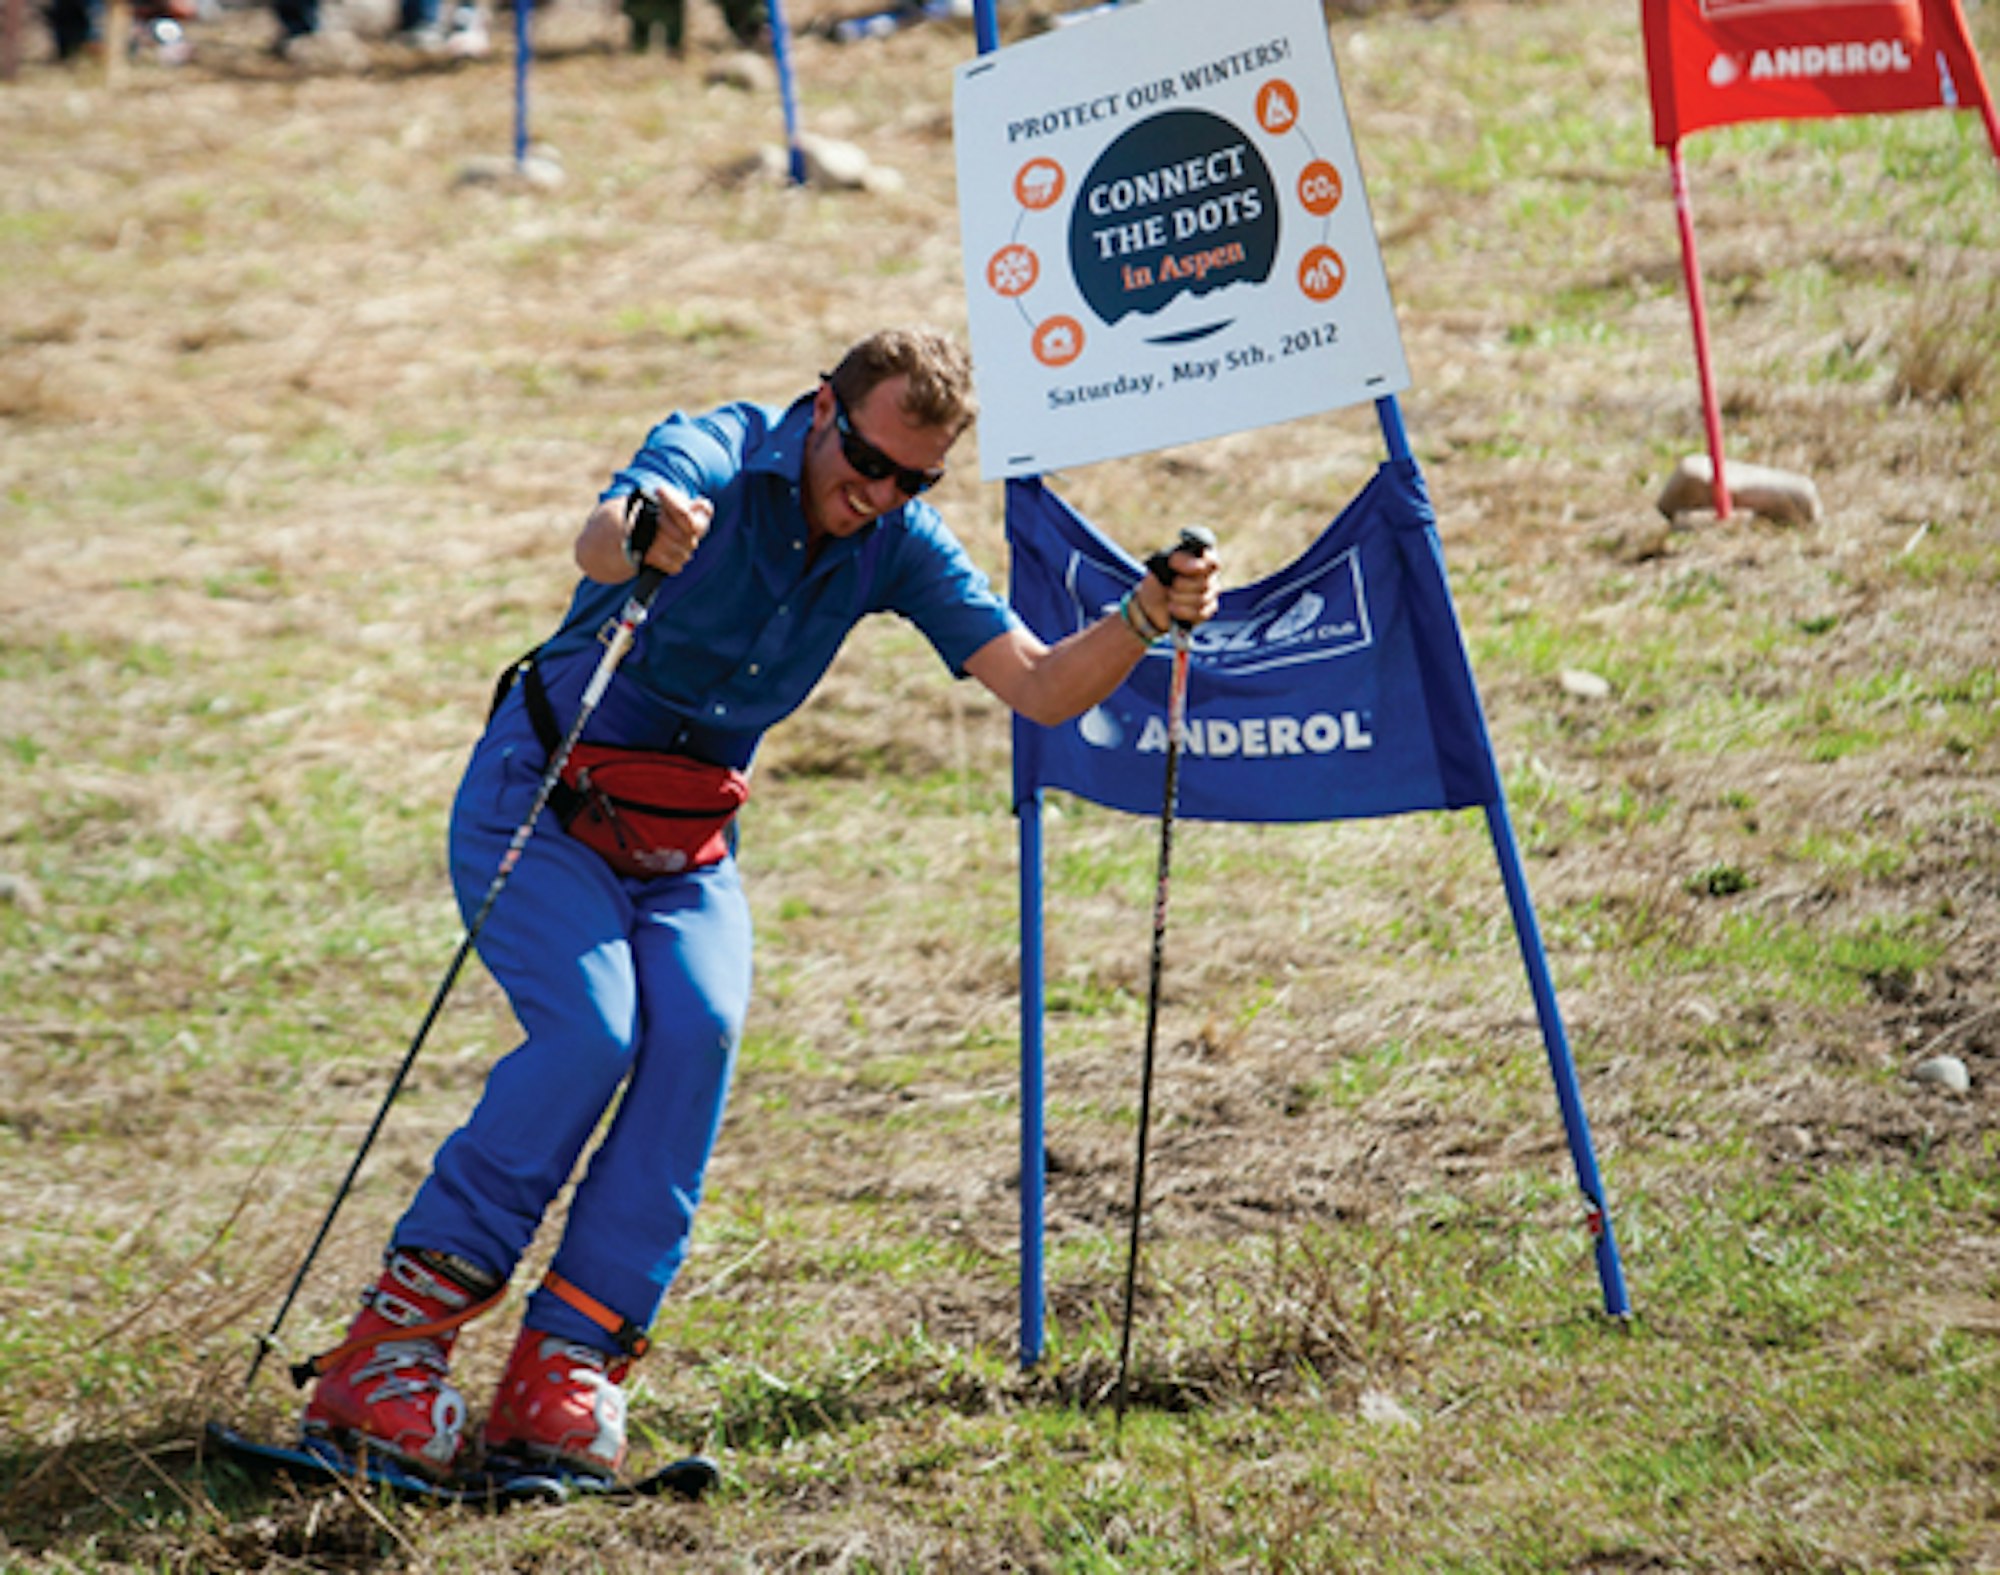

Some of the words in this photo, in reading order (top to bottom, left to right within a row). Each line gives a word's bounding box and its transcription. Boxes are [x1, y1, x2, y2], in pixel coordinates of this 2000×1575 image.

[1007, 94, 1121, 143] PROTECT
[1125, 78, 1178, 111] OUR
[1180, 37, 1292, 92] WINTERS!
[1749, 39, 1911, 79] ANDEROL
[1088, 144, 1246, 217] CONNECT
[1093, 214, 1168, 260] THE
[1171, 187, 1263, 241] DOTS
[1121, 262, 1154, 292] in
[1159, 241, 1246, 280] Aspen
[1047, 372, 1164, 409] Saturday,
[1171, 357, 1220, 383] May
[1225, 344, 1275, 371] 5th,
[1281, 322, 1339, 356] 2012
[1135, 709, 1373, 757] ANDEROL
